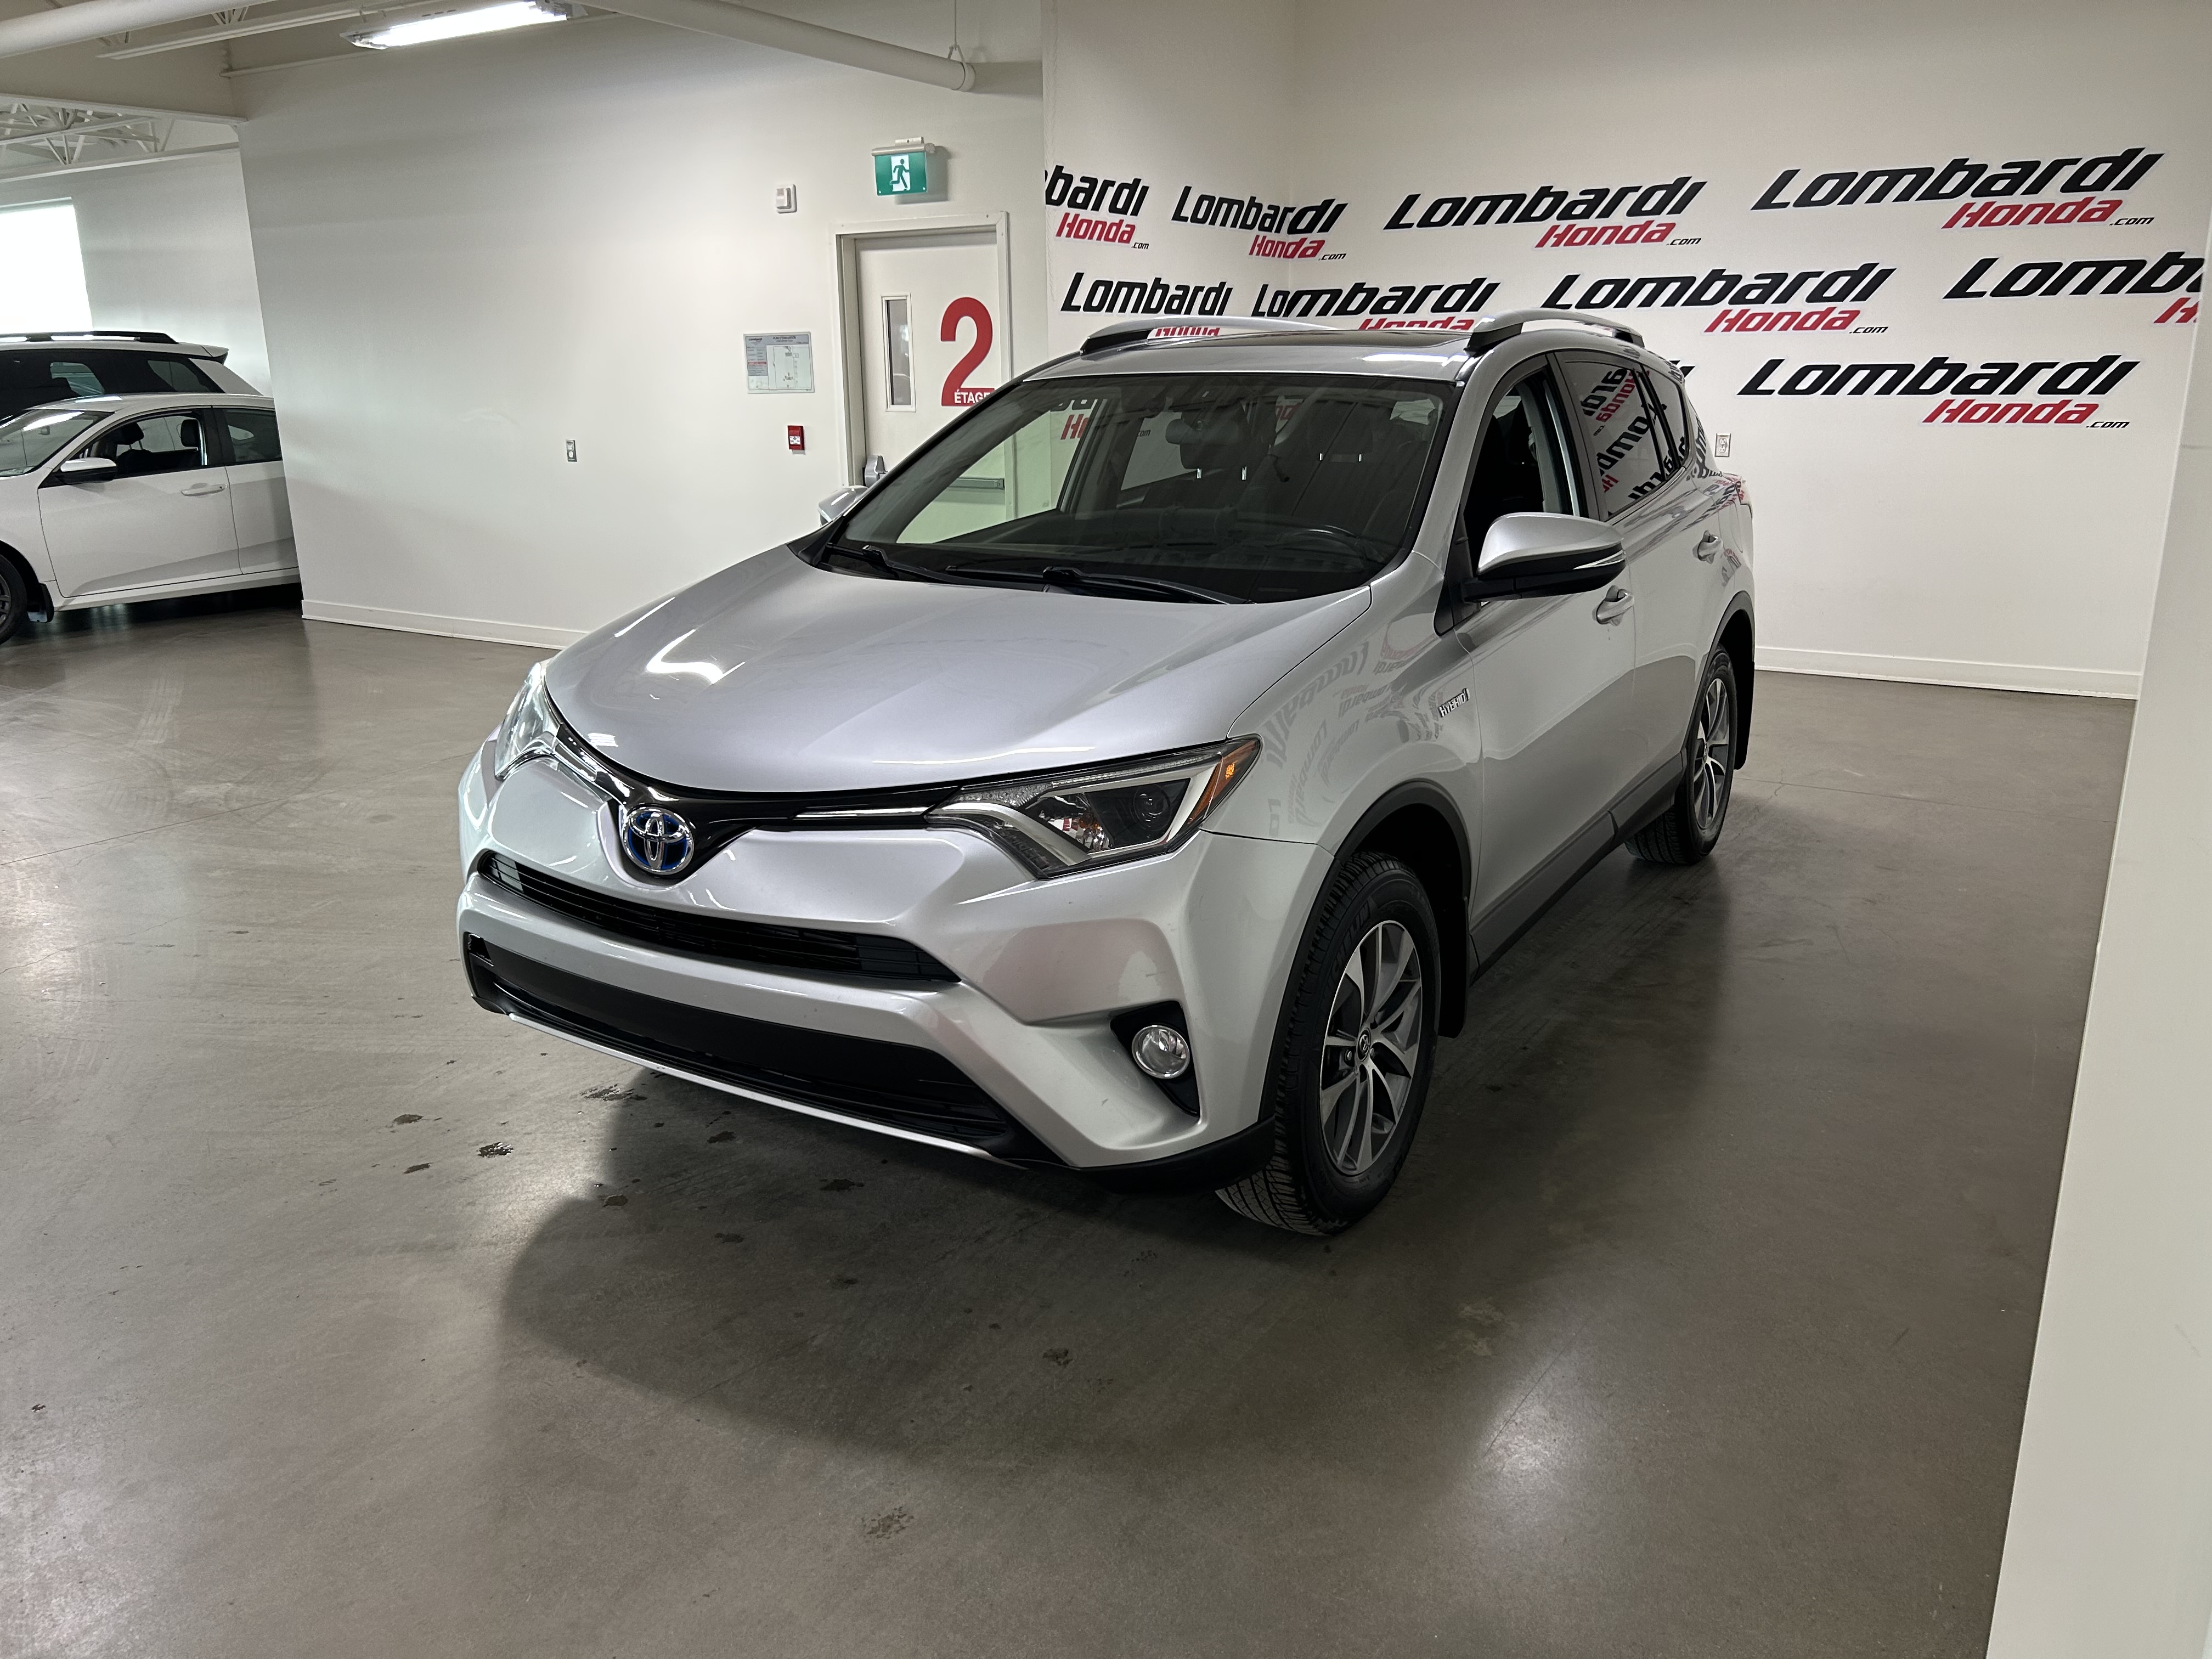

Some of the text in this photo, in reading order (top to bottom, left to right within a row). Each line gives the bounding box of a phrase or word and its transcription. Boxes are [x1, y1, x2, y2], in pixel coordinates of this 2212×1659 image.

[1045, 165, 1150, 217] bardi
[1751, 147, 2164, 210] Lombardi
[1171, 185, 1348, 235] Lombardi
[1383, 176, 1707, 230] Lombardi
[1942, 196, 2155, 229] Honda .com
[1056, 212, 1136, 244] Honda
[1249, 234, 1326, 259] Honda
[1535, 220, 1701, 248] Honda .com
[1060, 272, 1233, 316] Lombardi
[1250, 277, 1501, 318] Lombardi
[1540, 262, 1897, 308] Lombardi
[1703, 307, 1861, 332] Honda
[940, 296, 995, 407] 2
[1736, 354, 2141, 396] Lombardi
[1921, 399, 2131, 429] Honda .com
[1438, 689, 1469, 718] HYBRID
